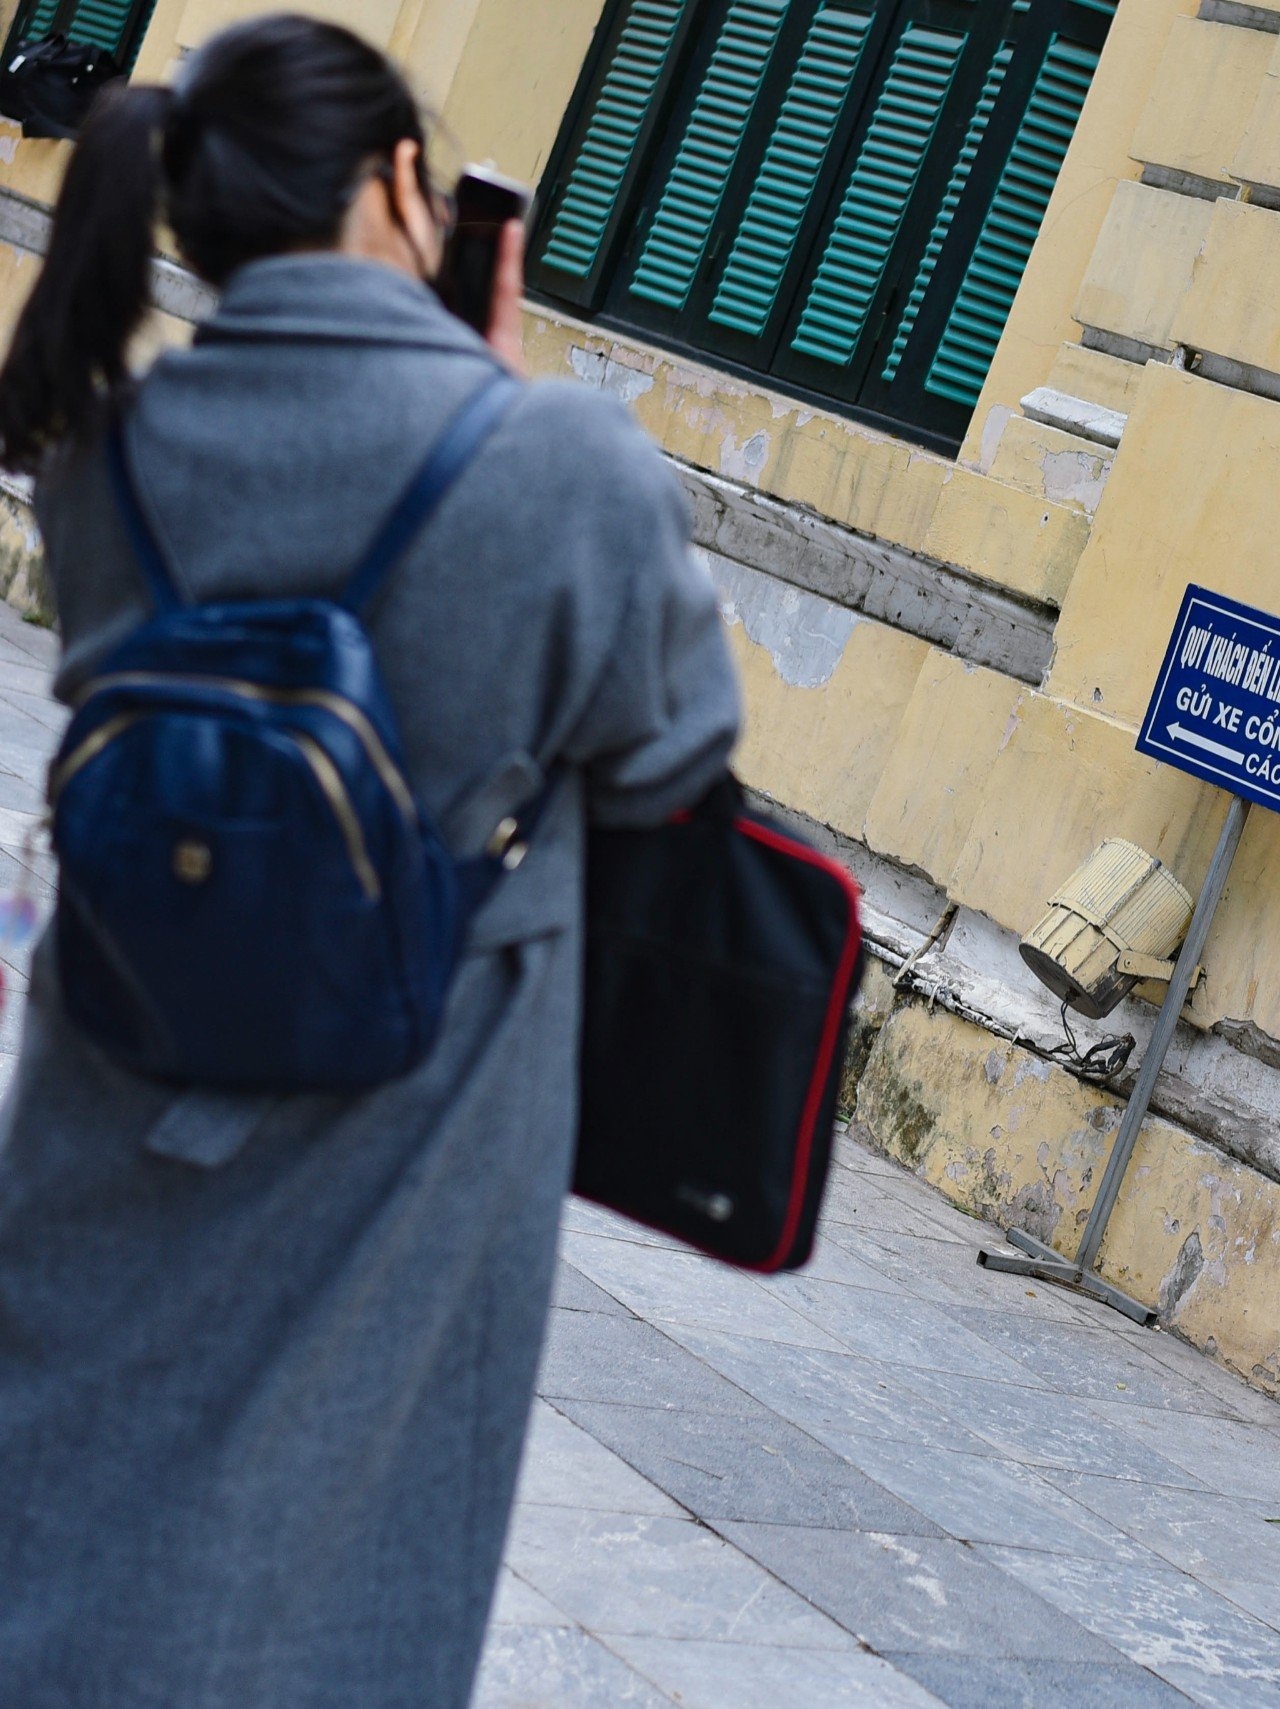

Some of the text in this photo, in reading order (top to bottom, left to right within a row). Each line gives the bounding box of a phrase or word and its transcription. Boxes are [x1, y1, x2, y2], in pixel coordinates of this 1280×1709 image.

[1181, 623, 1213, 669] QUÝ
[1203, 632, 1250, 686] KHÁCH
[1242, 640, 1275, 696] ĐẾN
[1212, 701, 1244, 733] XE
